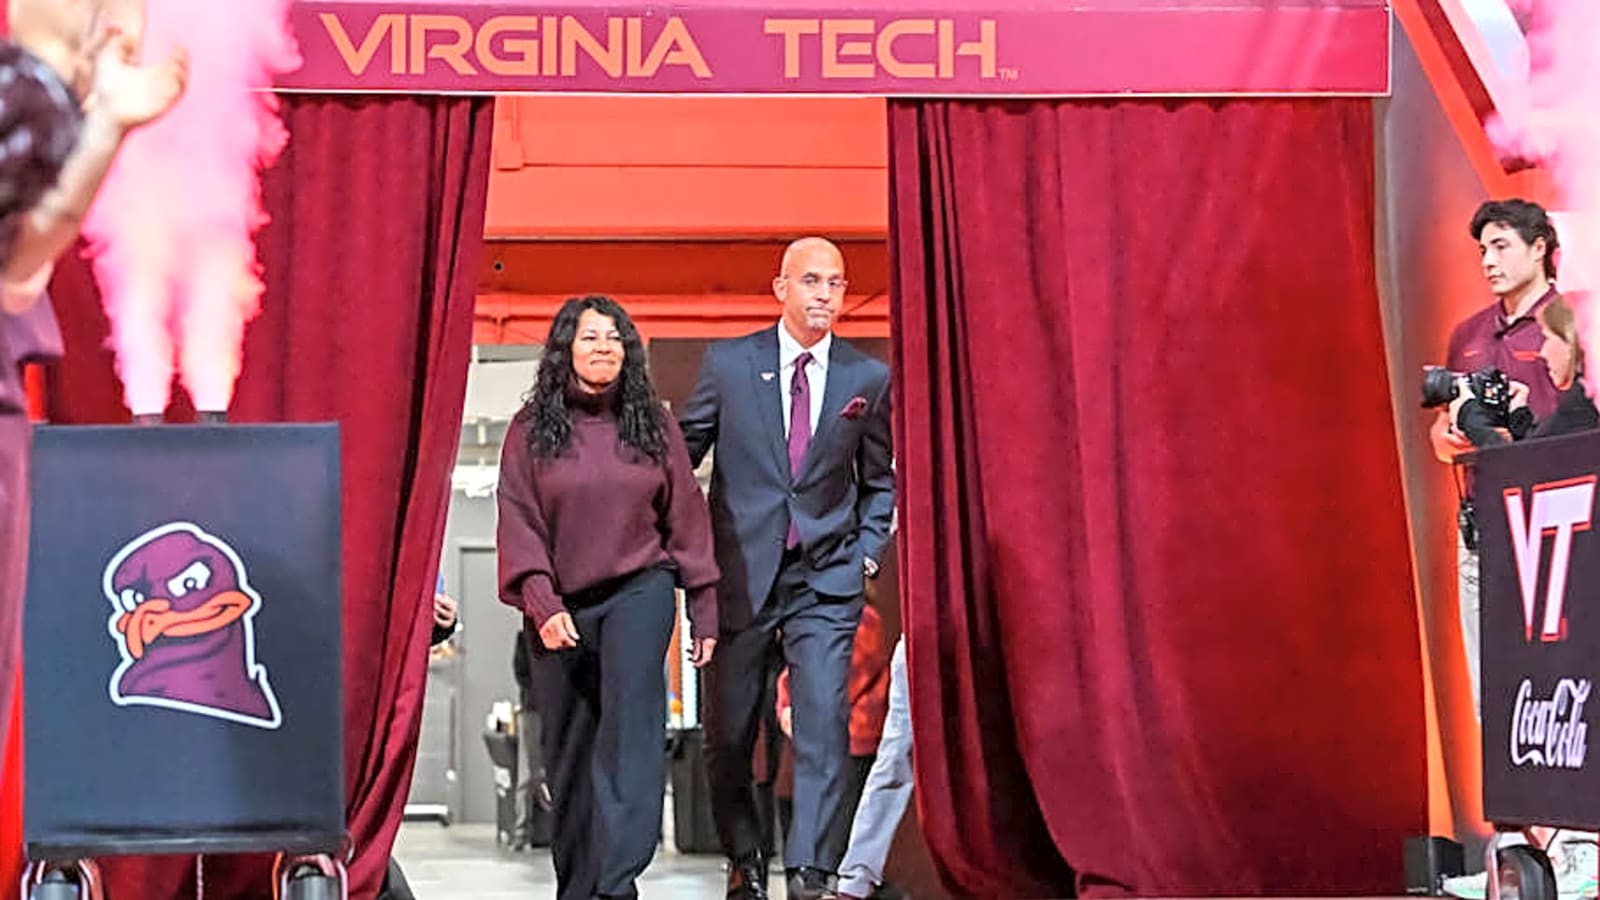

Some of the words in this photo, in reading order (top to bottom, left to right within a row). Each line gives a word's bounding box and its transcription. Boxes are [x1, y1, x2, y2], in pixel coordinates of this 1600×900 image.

[319, 13, 713, 78] VIRGINIA
[764, 18, 997, 79] TECH
[1502, 474, 1598, 642] VT
